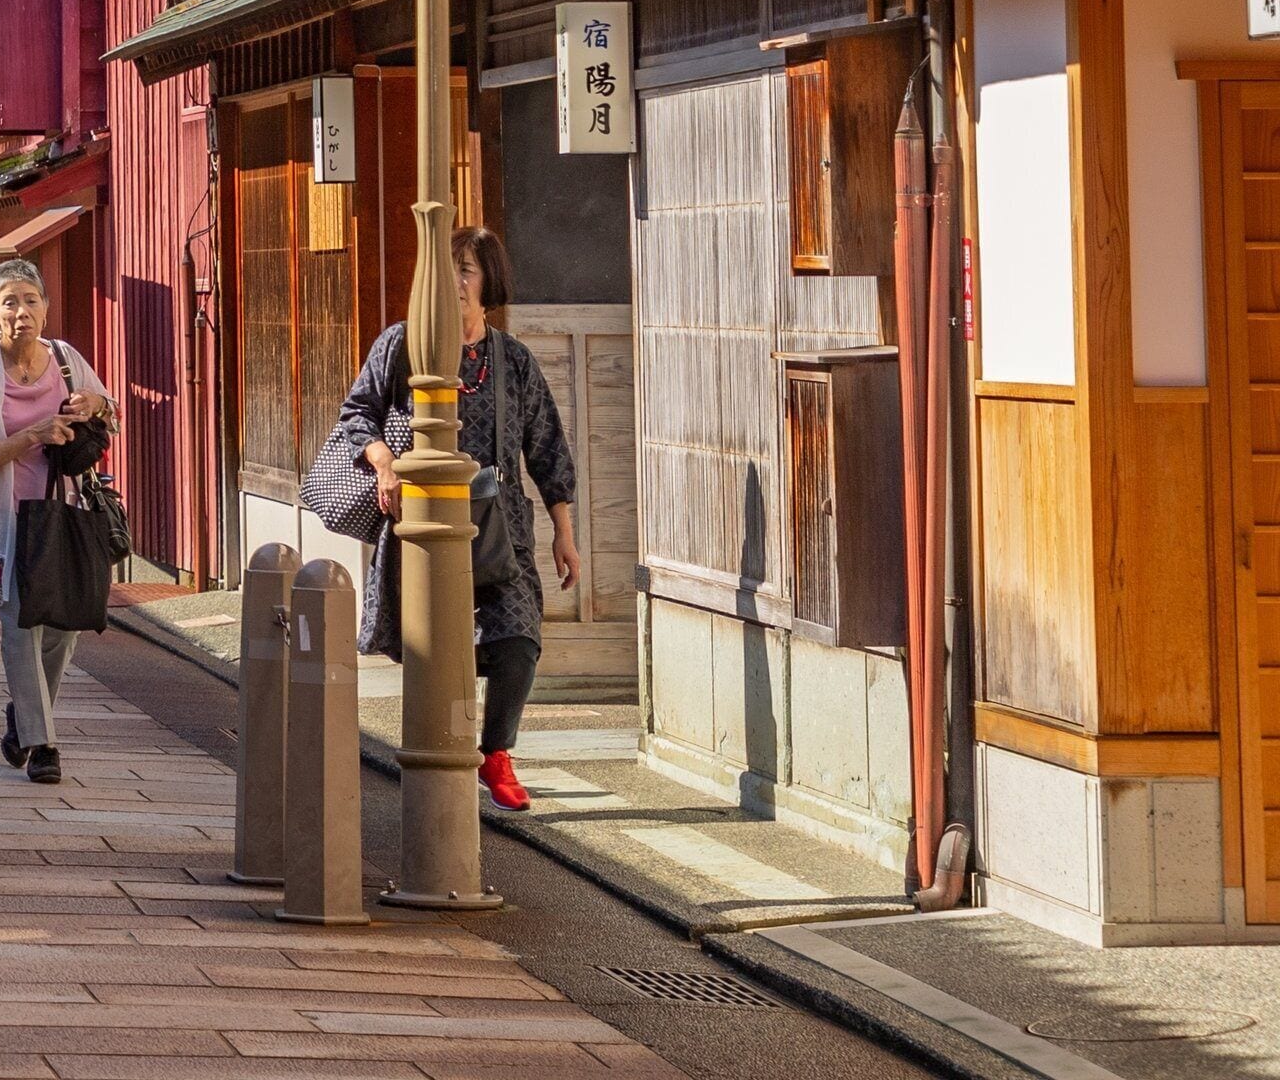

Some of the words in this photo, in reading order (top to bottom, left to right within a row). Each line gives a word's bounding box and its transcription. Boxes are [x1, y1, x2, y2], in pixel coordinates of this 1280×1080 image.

[583, 19, 617, 135] 宿陽月
[328, 125, 339, 171] ひがし
